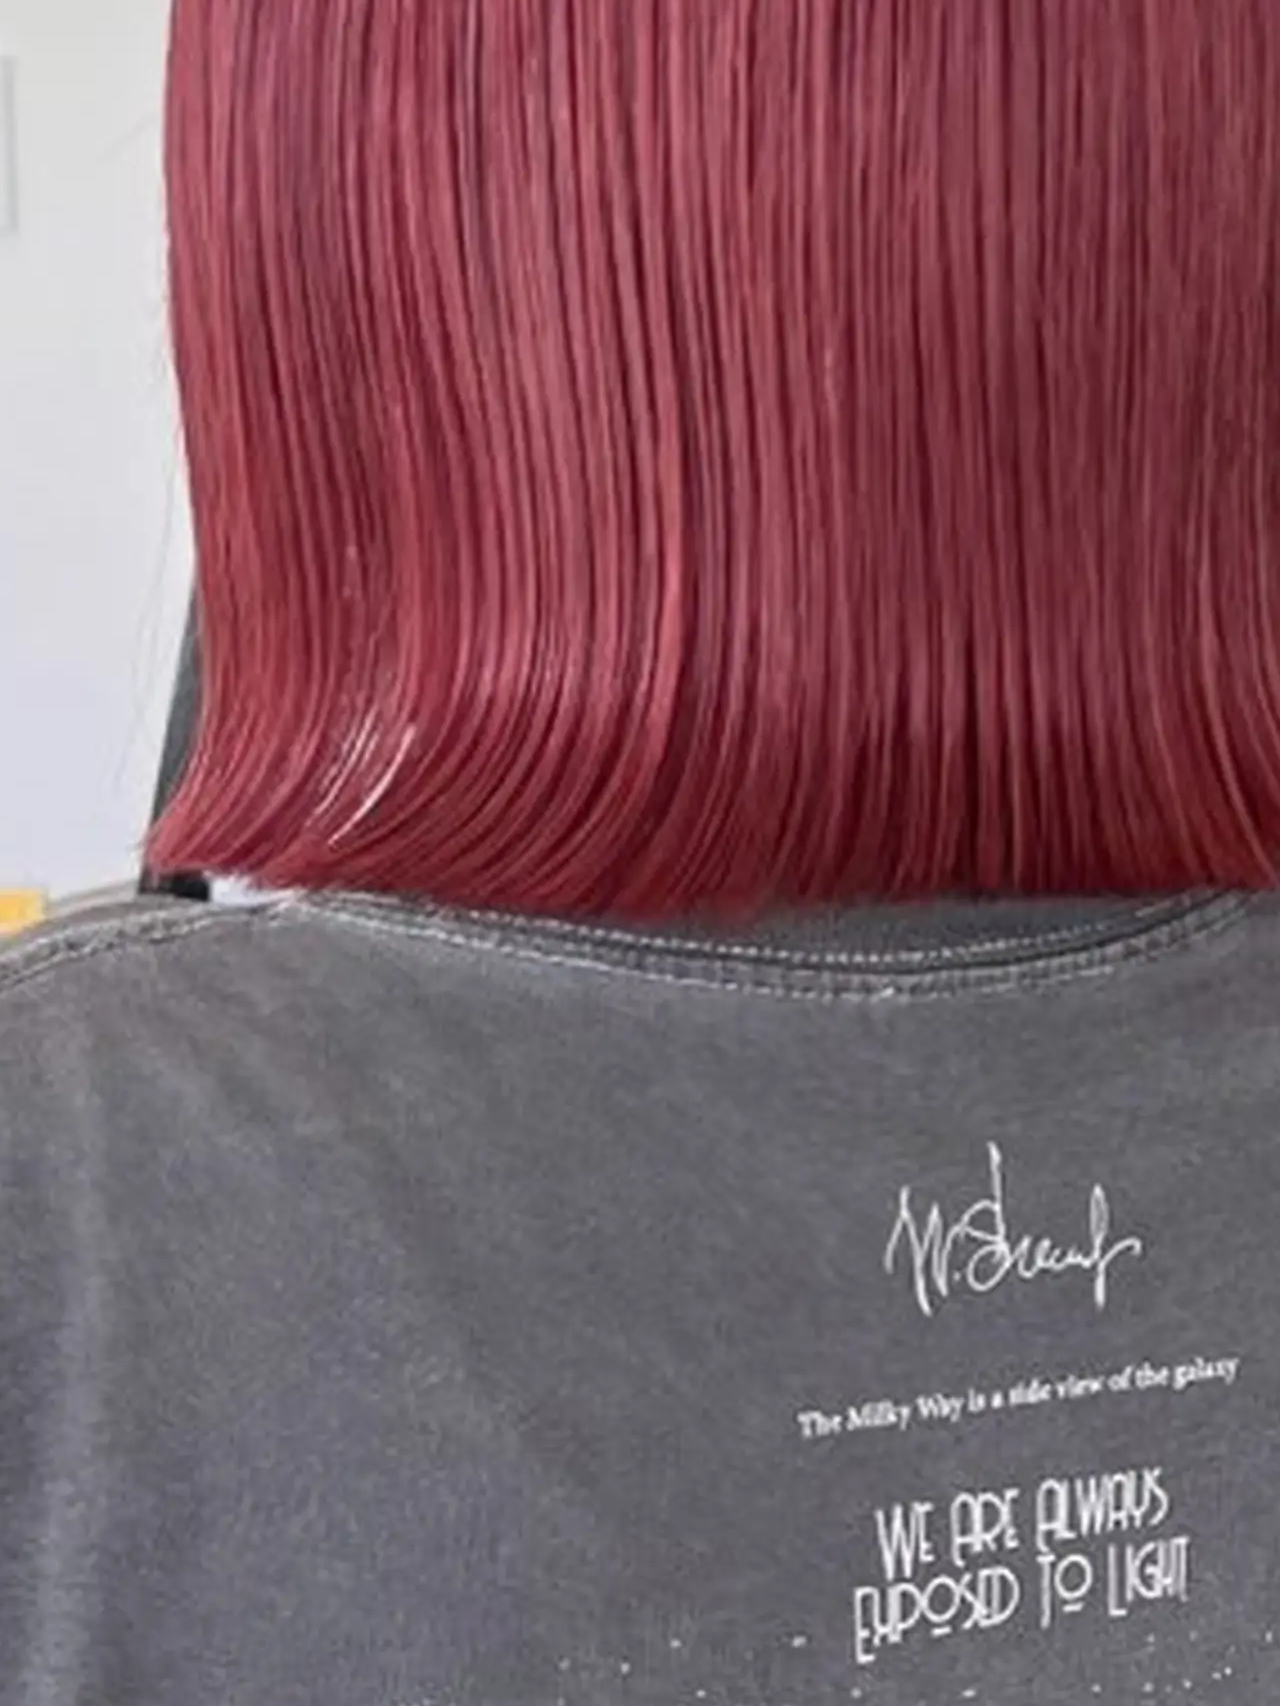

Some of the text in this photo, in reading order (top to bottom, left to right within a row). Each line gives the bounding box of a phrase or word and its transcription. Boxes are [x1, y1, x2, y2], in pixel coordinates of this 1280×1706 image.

[797, 1356, 1240, 1437] The Milky Way is a side view of the galaxy
[875, 1467, 1169, 1582] WE ARE ALWAYS
[854, 1535, 1189, 1665] EXPOSED TO LIGHT
